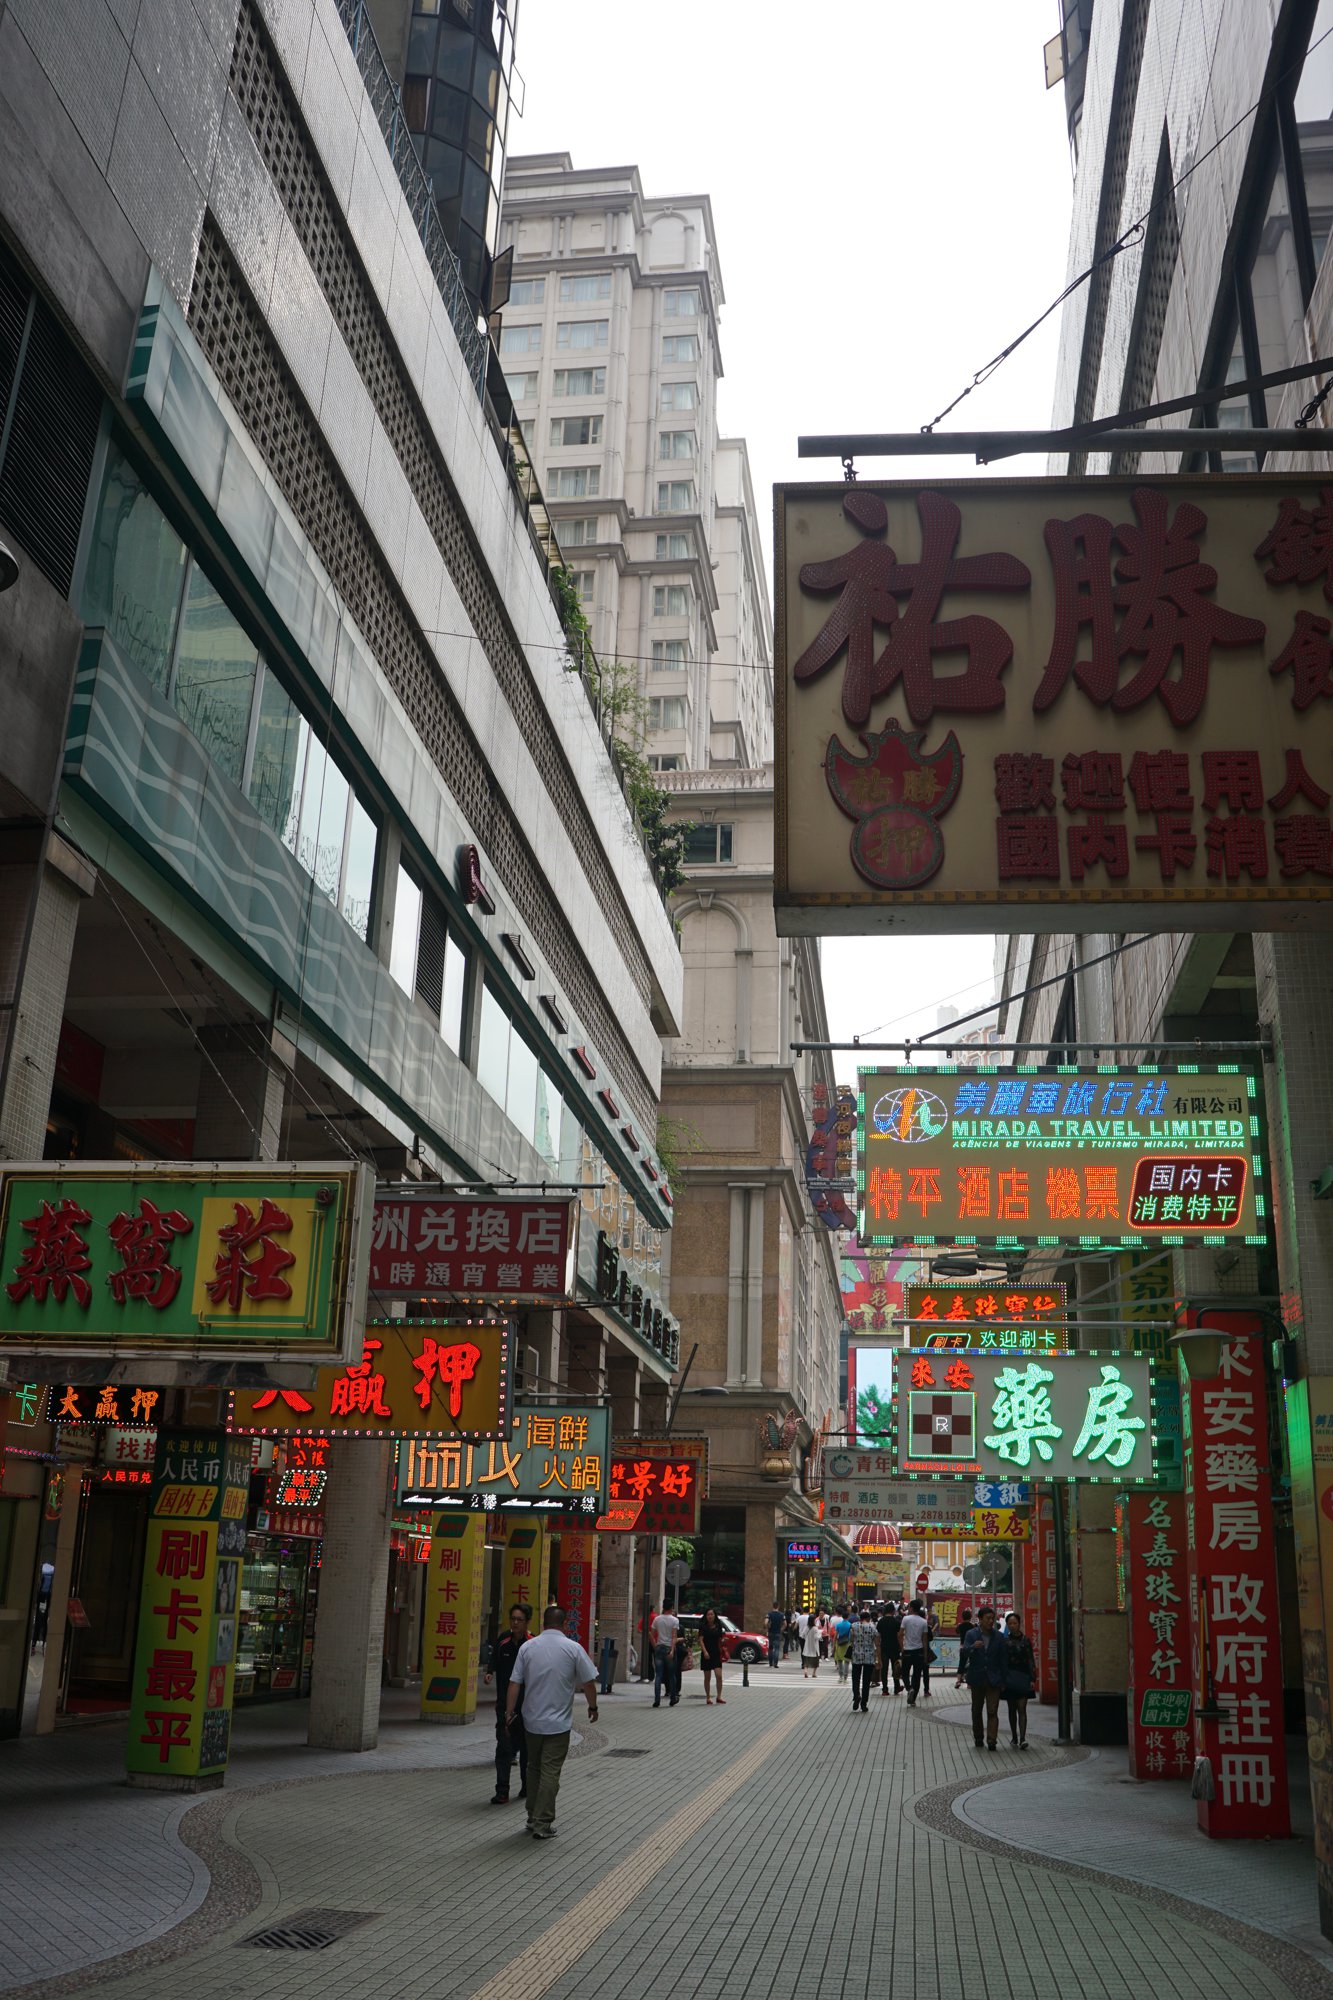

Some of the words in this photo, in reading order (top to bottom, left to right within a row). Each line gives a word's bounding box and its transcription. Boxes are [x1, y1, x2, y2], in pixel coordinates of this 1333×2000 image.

[954, 1080, 1170, 1116] 美麗華旅行社
[1172, 1097, 1243, 1114] 有限公司
[953, 1121, 1042, 1136] MIRADA
[1051, 1121, 1141, 1136] TRAVEL
[1150, 1121, 1243, 1137] LIMITED
[1194, 1140, 1245, 1148] LIMITADA
[870, 1166, 942, 1219] 特平
[957, 1166, 1030, 1219] 酒店
[1046, 1166, 1120, 1219] 機票
[1150, 1164, 1232, 1191] 国内卡
[527, 1415, 588, 1450] 海鮮
[984, 1363, 1146, 1467] 藥房
[158, 1458, 221, 1482] 人民币
[538, 1455, 600, 1491] 火鍋
[157, 1488, 213, 1515] 国内卡
[433, 1549, 461, 1668] 刷卡最平
[140, 1530, 209, 1764] 刷卡最平
